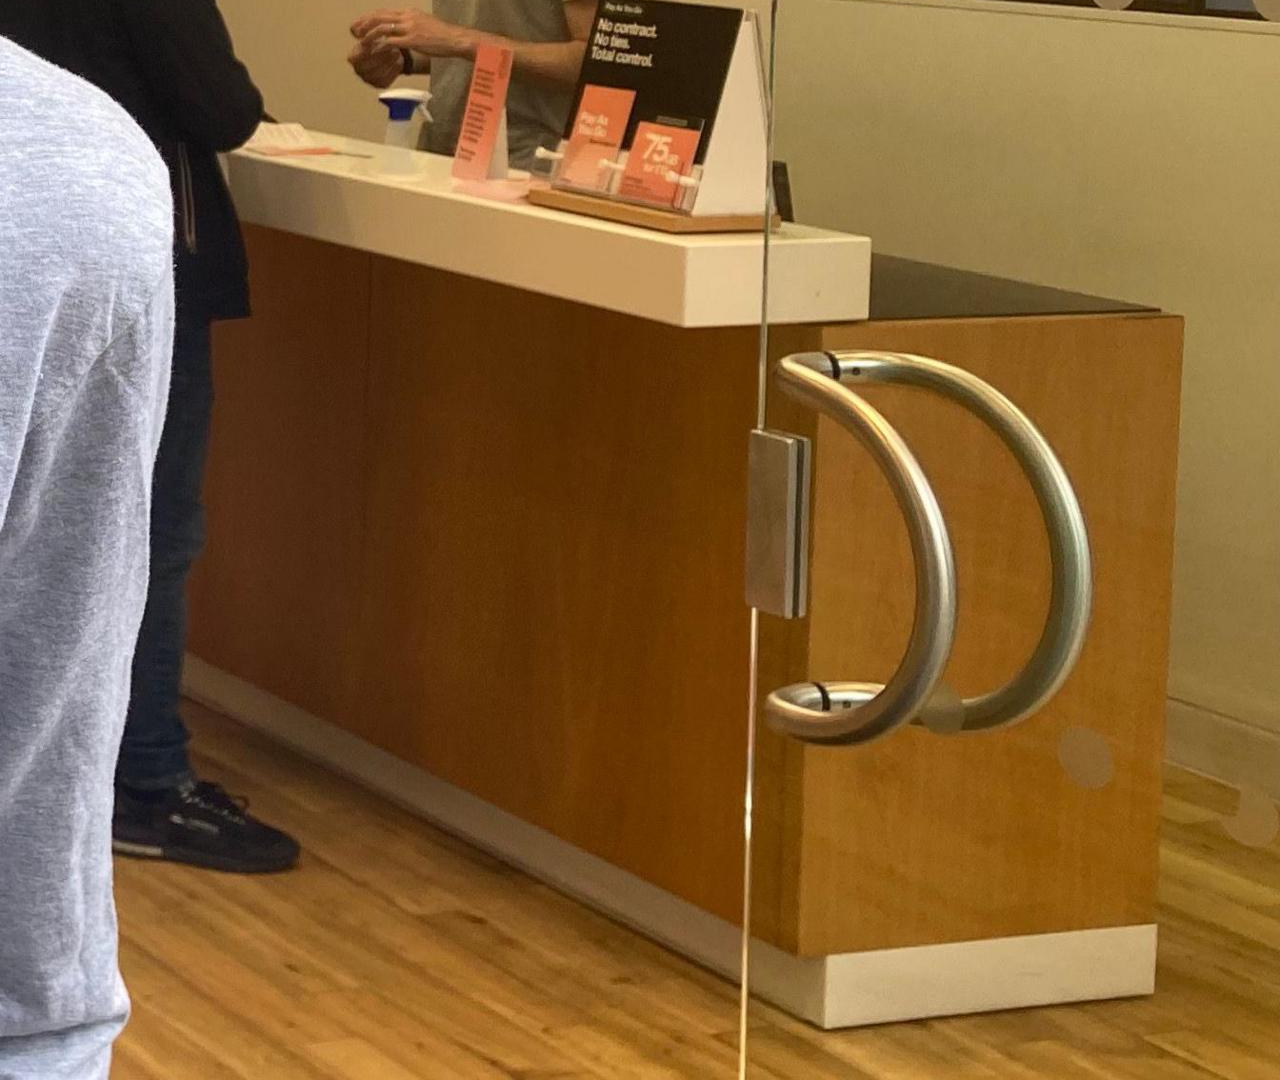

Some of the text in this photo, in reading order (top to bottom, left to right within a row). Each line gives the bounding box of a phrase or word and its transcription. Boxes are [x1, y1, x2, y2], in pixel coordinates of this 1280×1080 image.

[598, 18, 657, 38] No contract.
[594, 32, 610, 46] No
[592, 46, 653, 67] Total control.
